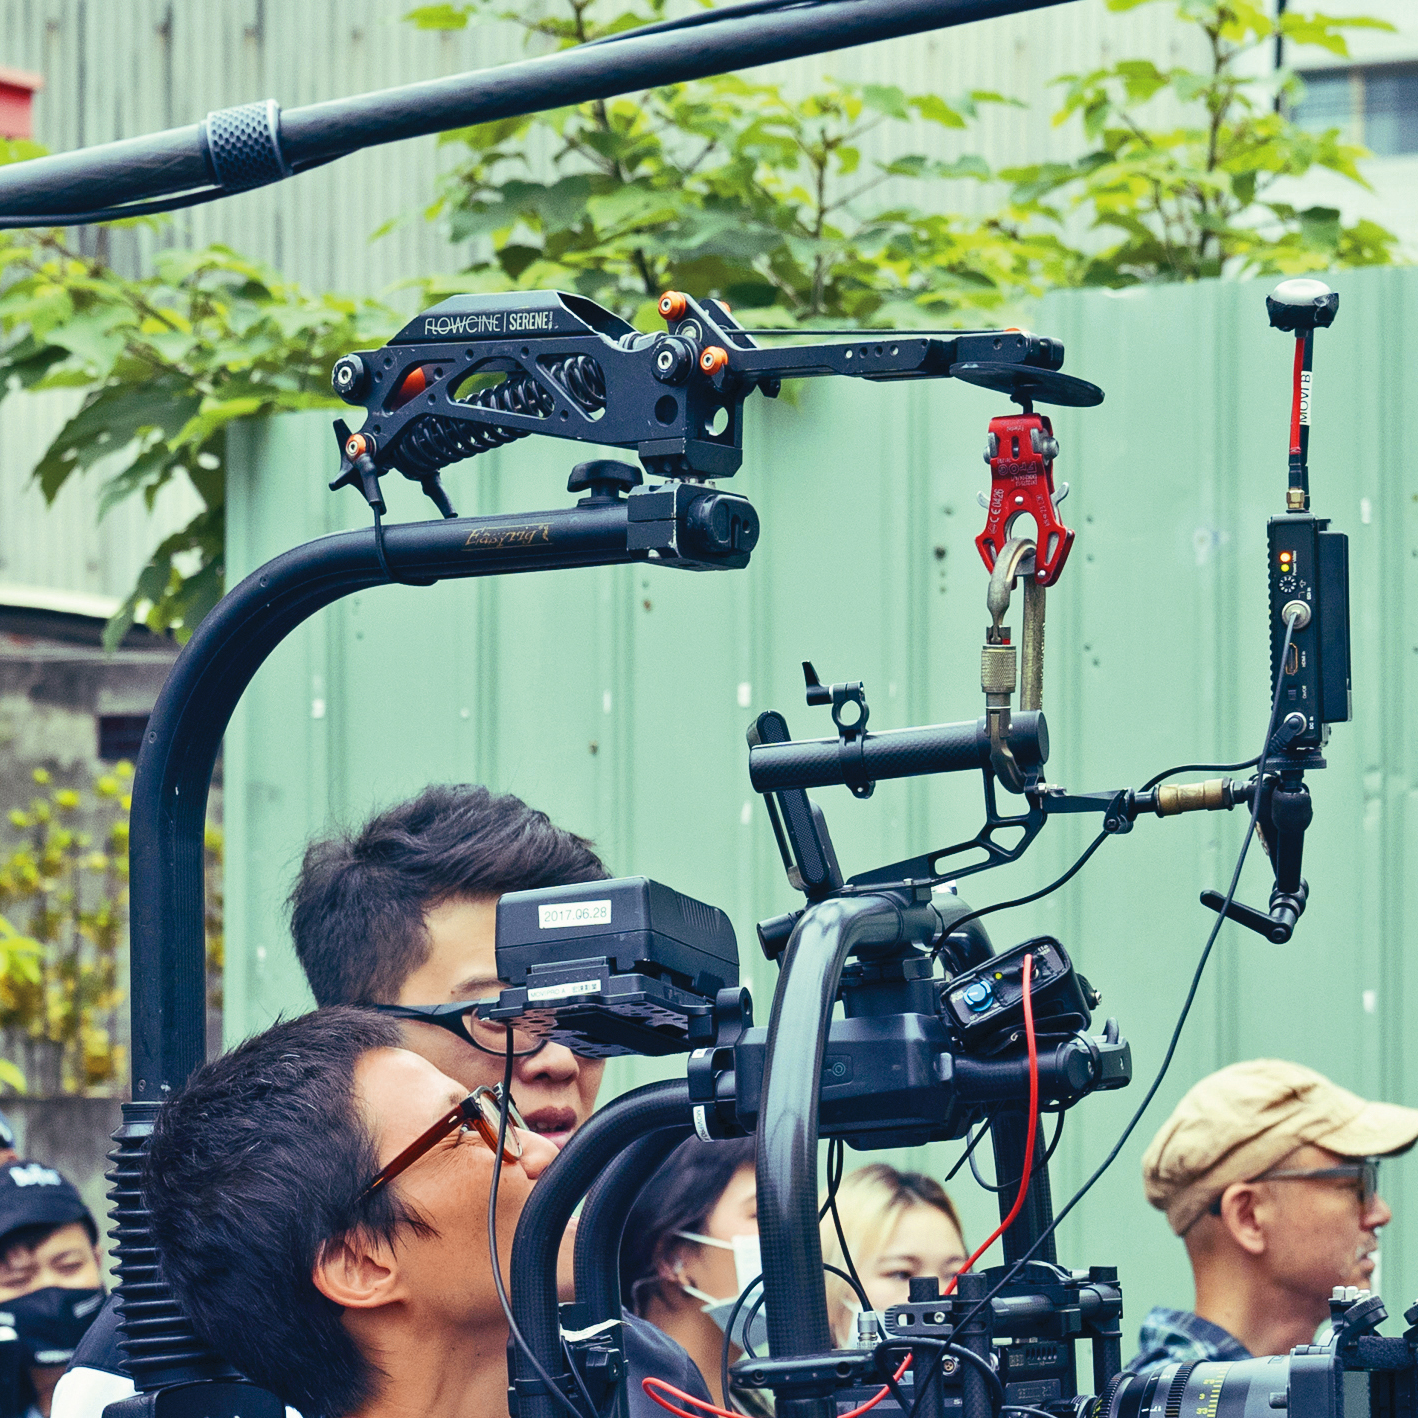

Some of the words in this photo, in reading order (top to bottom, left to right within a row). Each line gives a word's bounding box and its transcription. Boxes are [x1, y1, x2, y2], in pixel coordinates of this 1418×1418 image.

[424, 313, 502, 336] FLOWCINE
[509, 311, 549, 331] SERENE
[1301, 373, 1311, 383] B
[464, 526, 538, 548] Easyrig
[544, 906, 607, 922] 2017.06.28
[1196, 1407, 1208, 1415] 3'3
